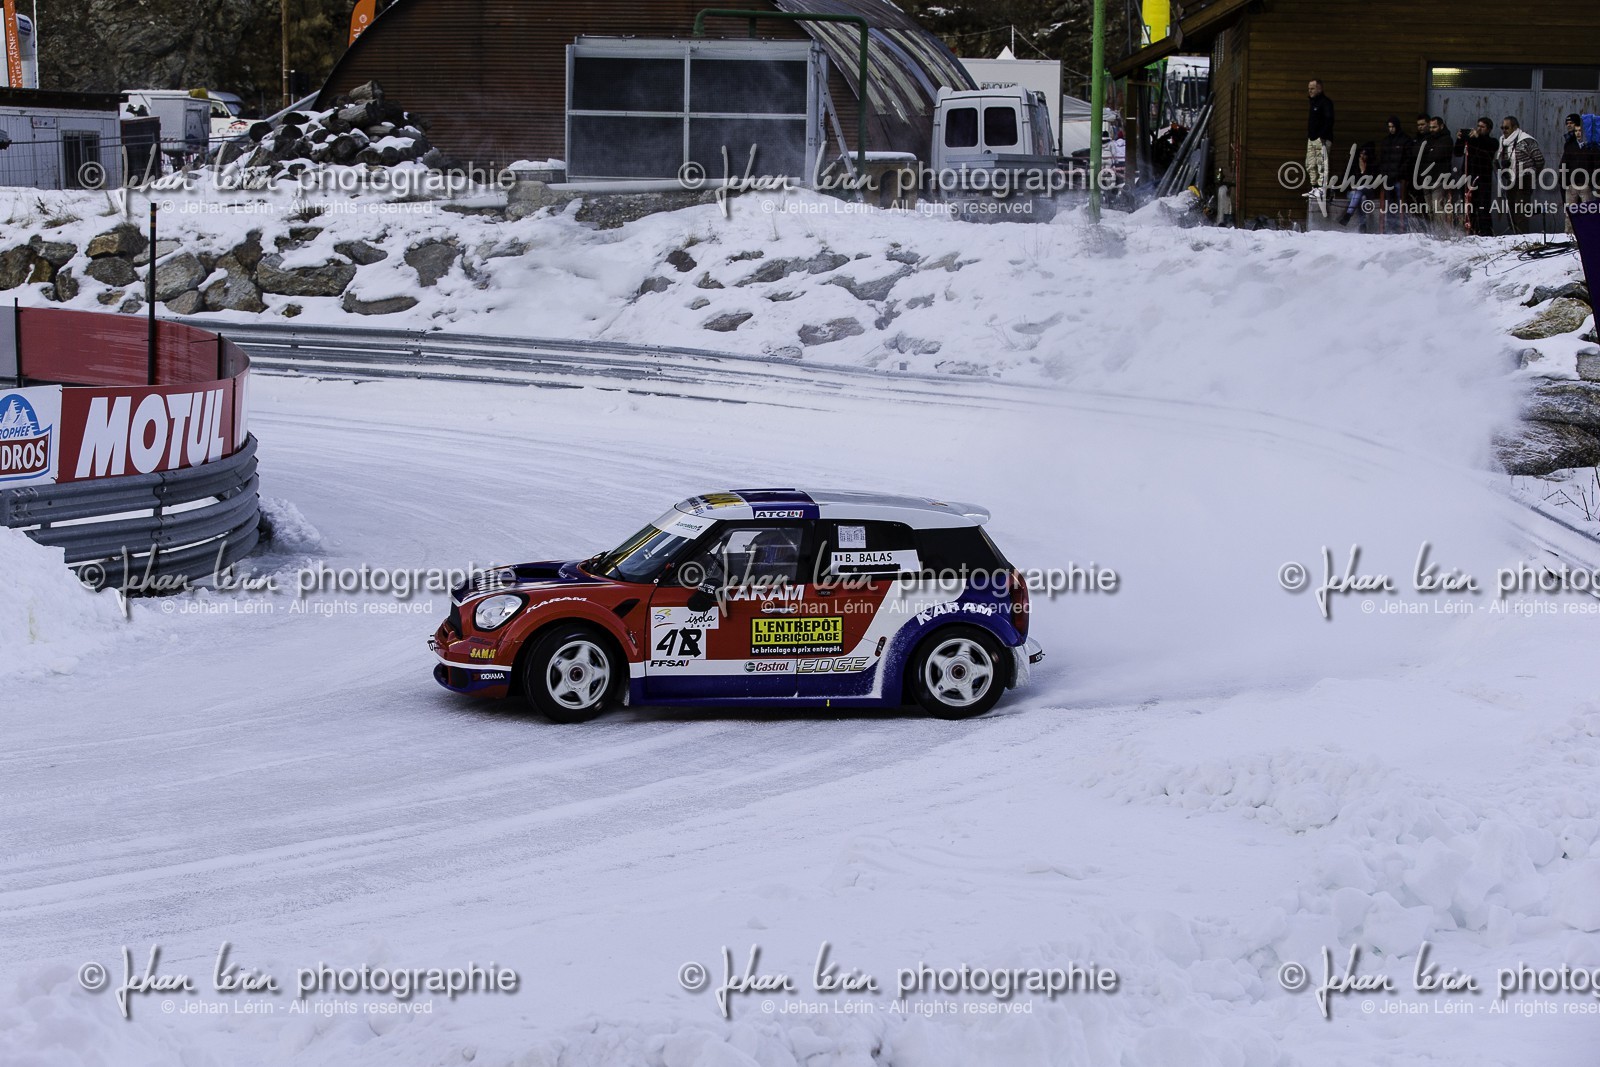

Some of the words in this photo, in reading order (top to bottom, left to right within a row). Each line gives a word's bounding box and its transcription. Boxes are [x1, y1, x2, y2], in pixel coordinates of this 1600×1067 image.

[75, 389, 224, 478] MOTUL
[0, 440, 45, 471] DROS
[845, 554, 854, 562] B.
[860, 552, 892, 562] BALAS
[685, 610, 716, 624] isola
[916, 602, 992, 626] KARAM
[755, 619, 839, 633] L'ENTREPÔT
[755, 634, 771, 642] DU
[774, 632, 840, 642] BRICOLAGE
[760, 646, 790, 654] bricolage
[798, 646, 810, 654] prix
[756, 662, 788, 672] Castrol
[798, 656, 868, 673] EDGE
